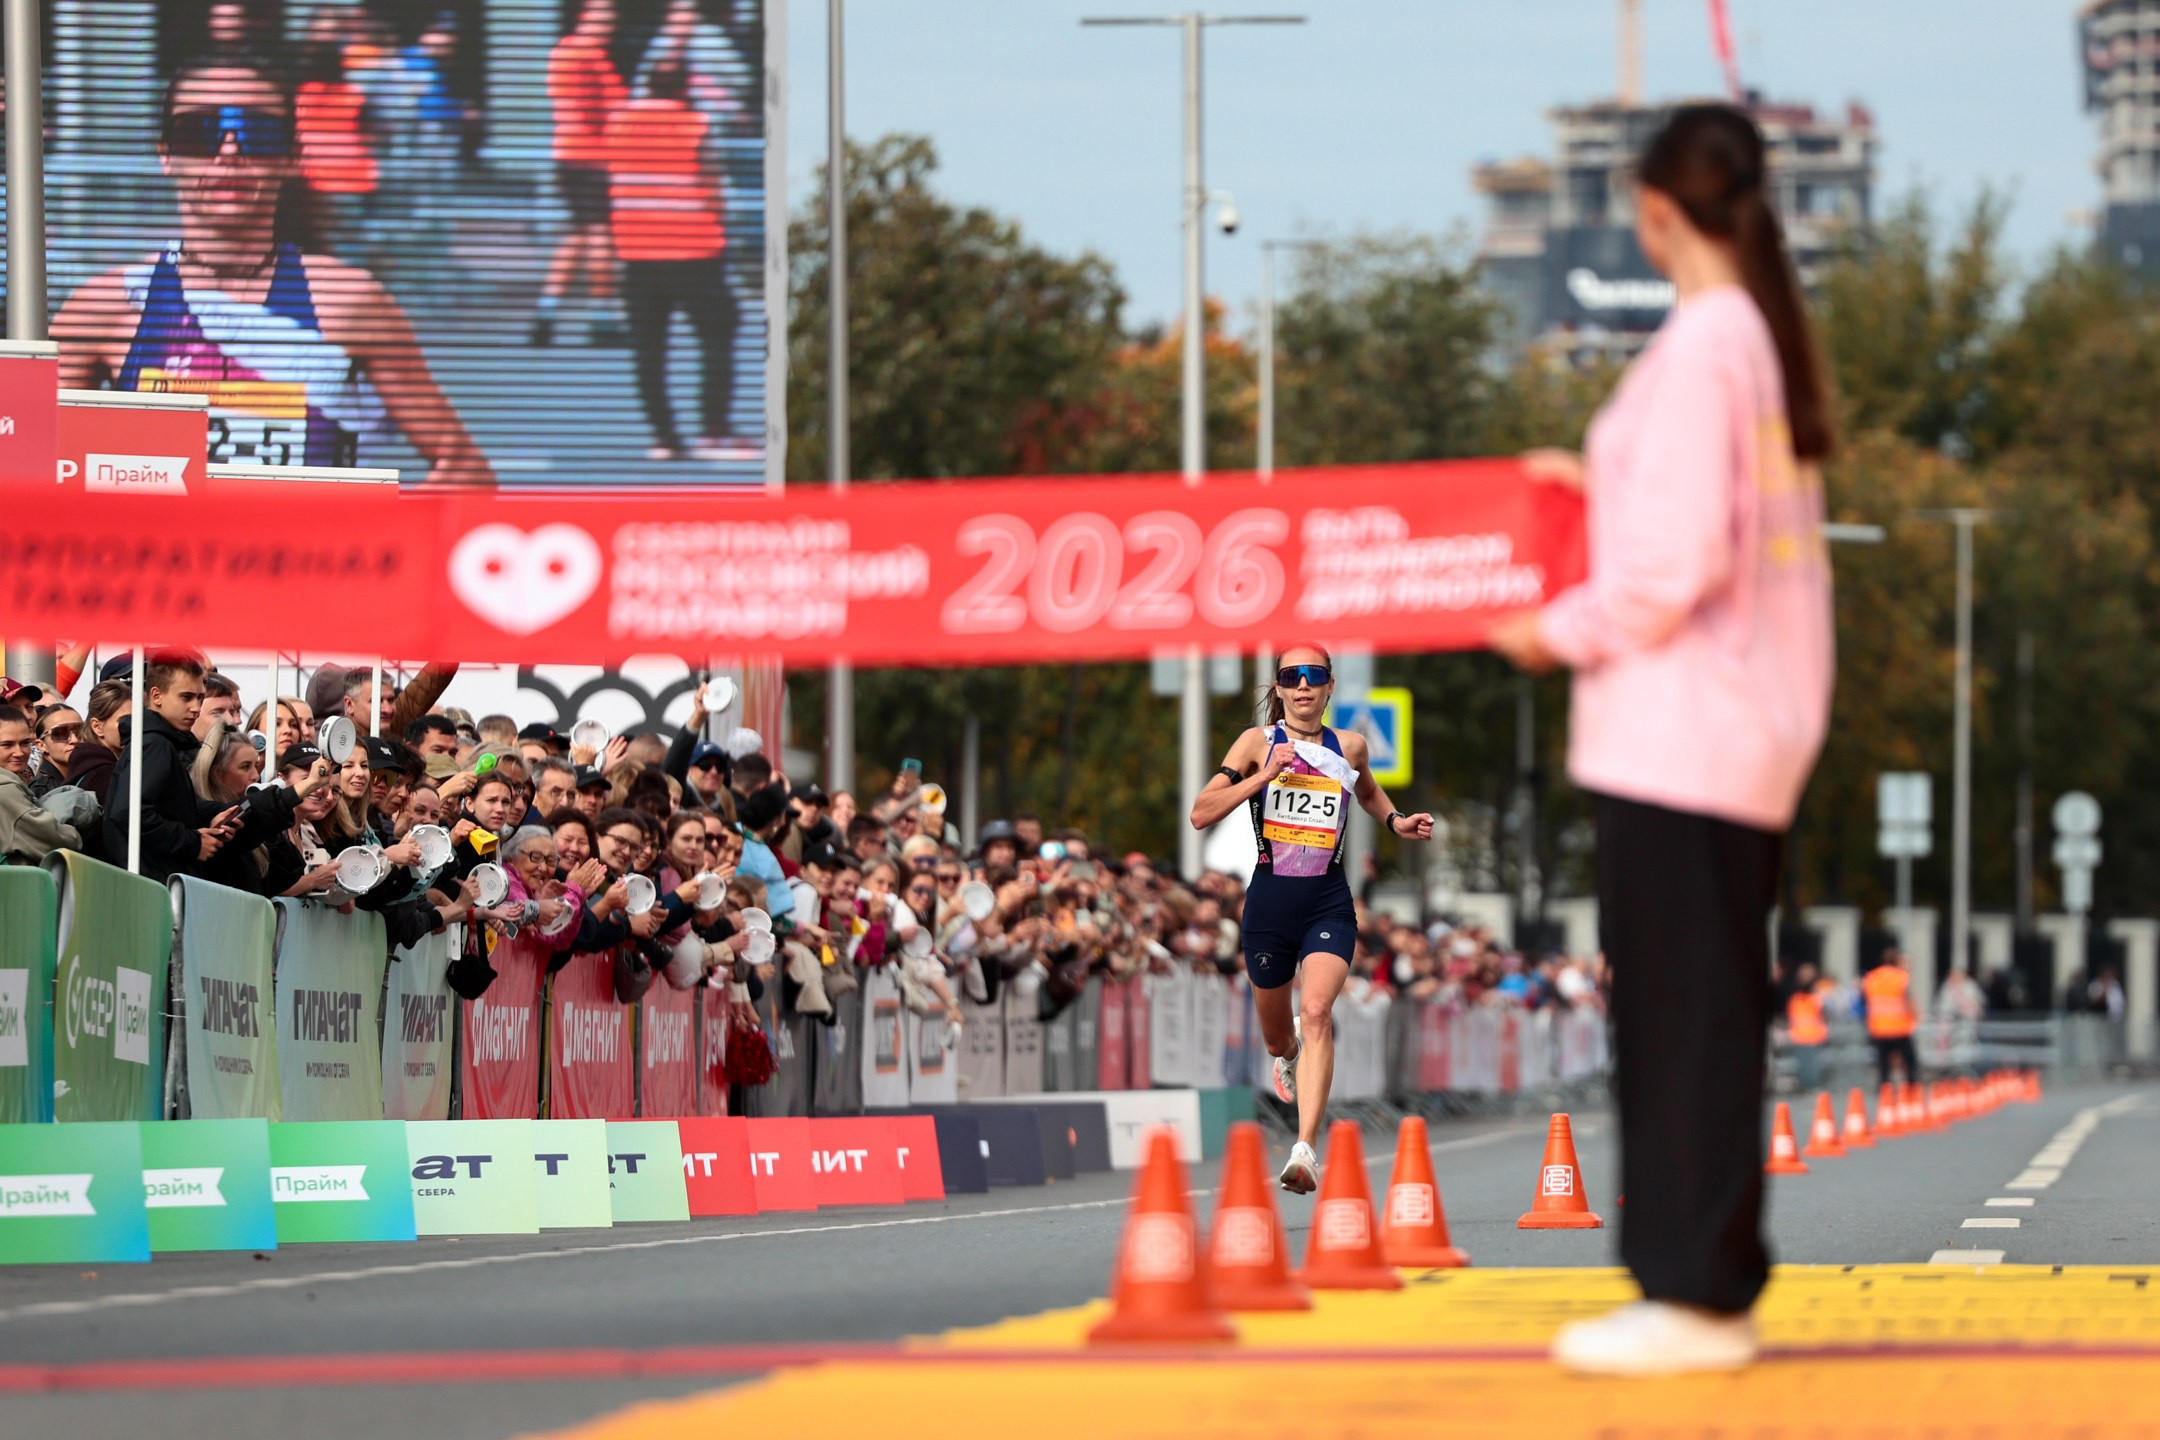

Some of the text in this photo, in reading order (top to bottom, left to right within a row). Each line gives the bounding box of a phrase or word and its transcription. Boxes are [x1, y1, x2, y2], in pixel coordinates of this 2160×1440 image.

[98, 464, 168, 485] Прайм
[940, 507, 1289, 635] 2026
[1273, 789, 1336, 817] 112-5
[275, 1175, 348, 1194] Прайм
[417, 1188, 456, 1197] СБЕРА
